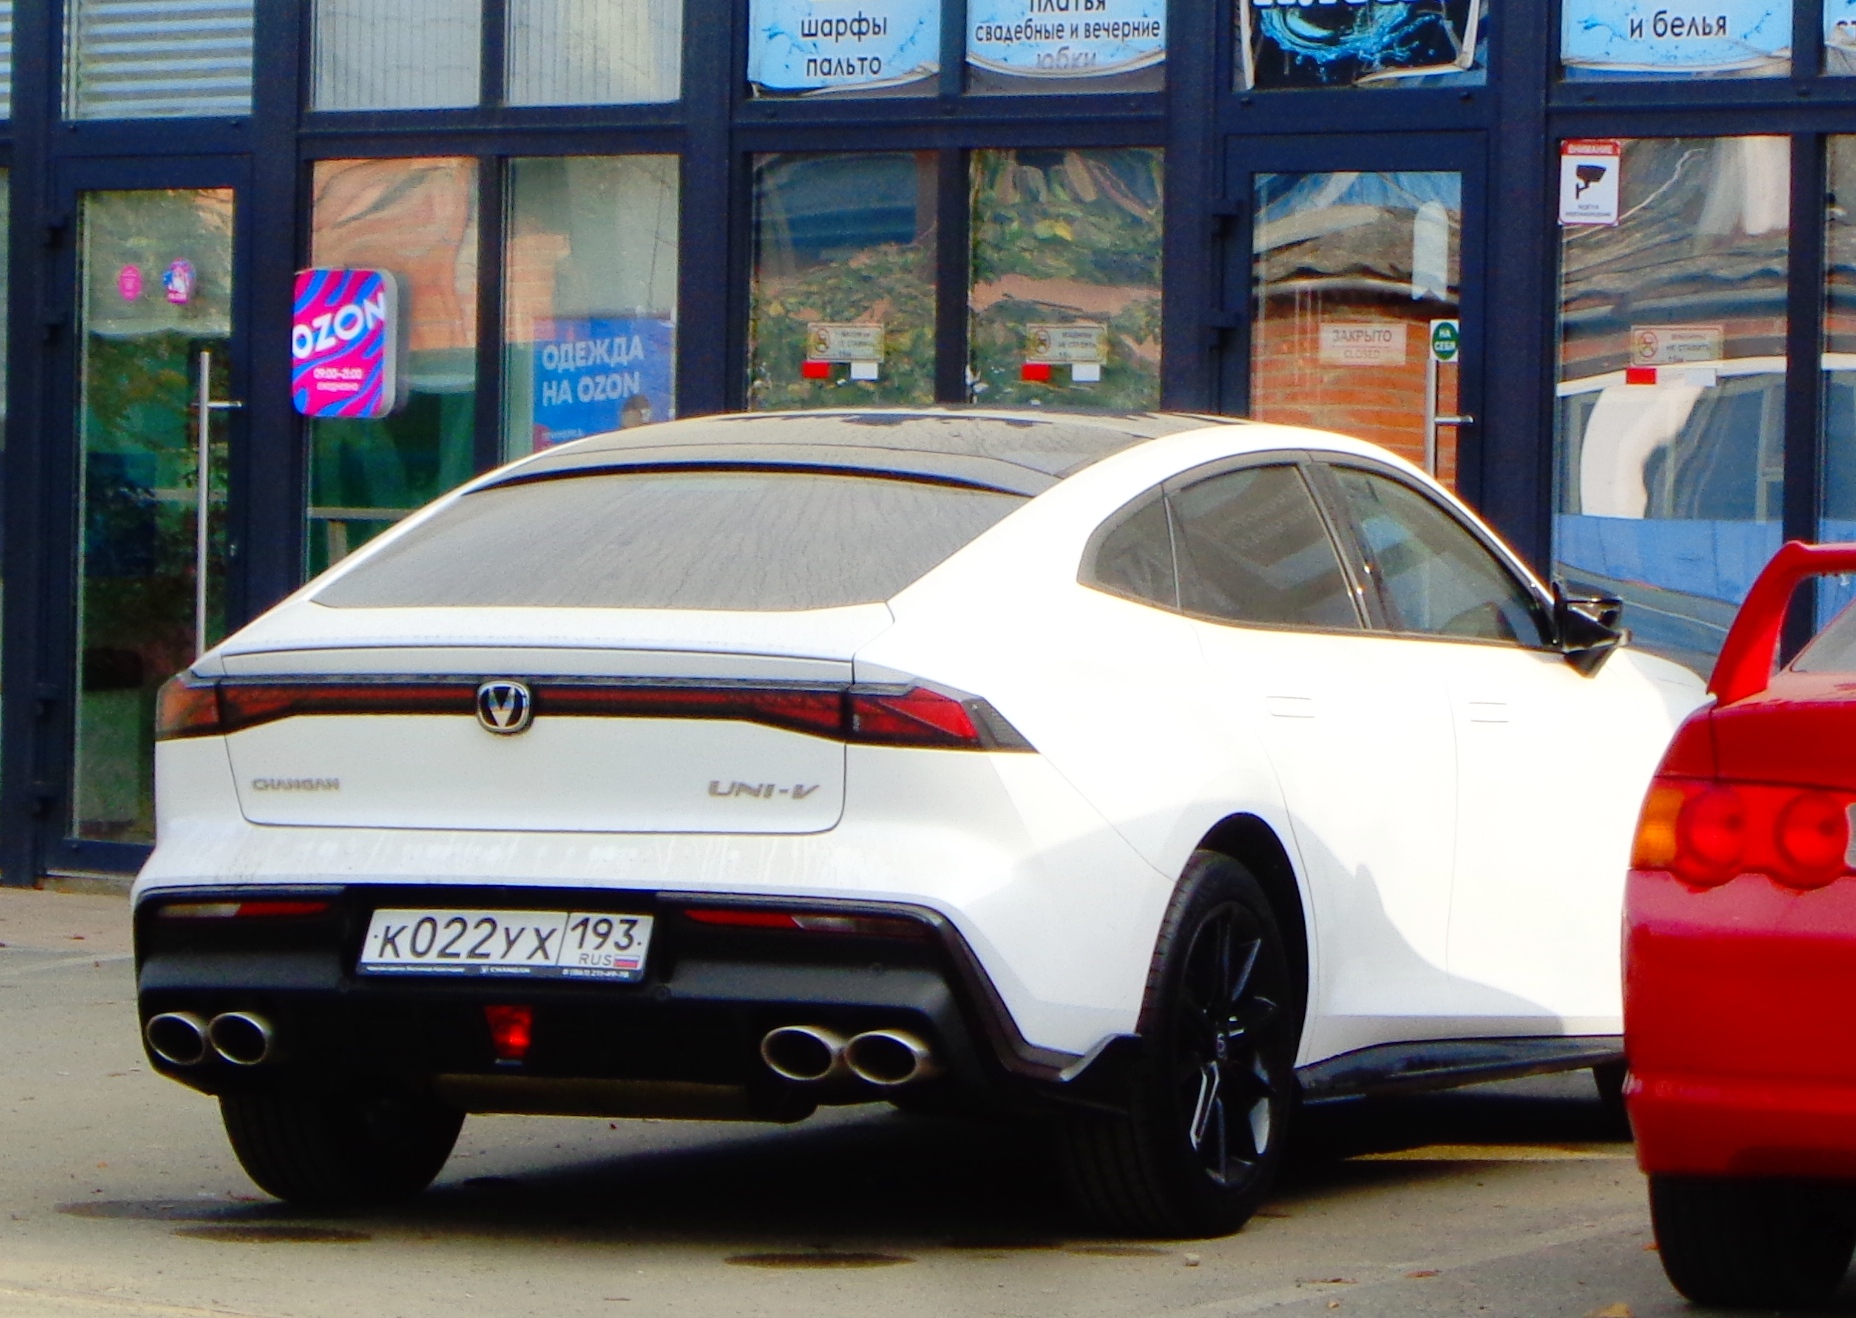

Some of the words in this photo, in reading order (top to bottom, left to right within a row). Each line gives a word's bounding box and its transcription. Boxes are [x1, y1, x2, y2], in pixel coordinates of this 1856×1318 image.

[801, 10, 887, 43] шарфы
[975, 18, 1065, 43] свадебные
[1069, 27, 1079, 39] и
[1084, 20, 1161, 42] вечерние
[1630, 18, 1643, 38] и
[1653, 9, 1727, 38] белья
[806, 56, 882, 76] пальто
[292, 292, 385, 359] OZON
[1332, 329, 1393, 343] ЗАКРЫТО
[542, 335, 645, 374] ОДЕЖДА
[1343, 349, 1380, 360] CLOSED
[542, 380, 573, 407] НА
[577, 371, 641, 403] OZON
[253, 777, 340, 792] CHANGAN
[708, 779, 820, 800] UNI-V
[378, 916, 558, 960] К022УХ
[570, 917, 638, 952] 193
[578, 953, 613, 966] RUS
